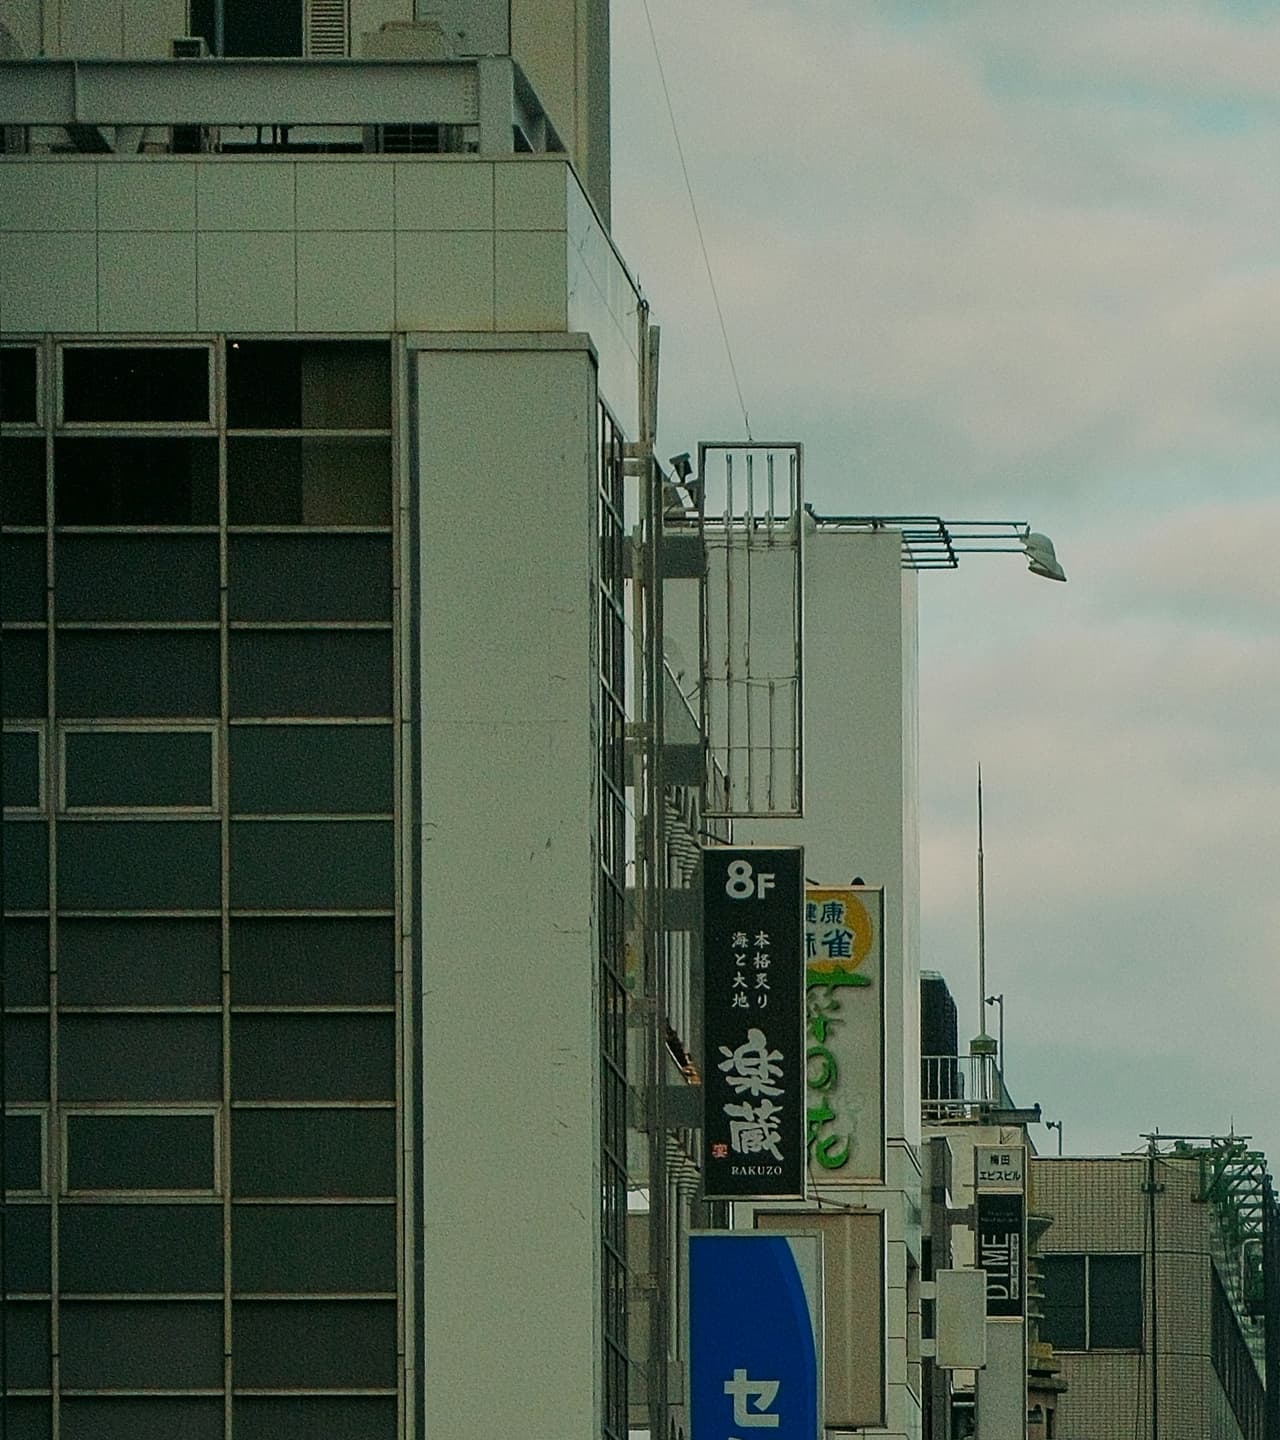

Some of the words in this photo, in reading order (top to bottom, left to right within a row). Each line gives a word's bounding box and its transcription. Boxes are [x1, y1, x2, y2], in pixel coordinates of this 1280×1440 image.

[724, 859, 776, 900] 8F
[731, 932, 749, 1009] 海と大地
[717, 1027, 785, 1161] 楽蔵
[731, 1166, 783, 1176] RAKUZO
[990, 1155, 1010, 1166] 梅田
